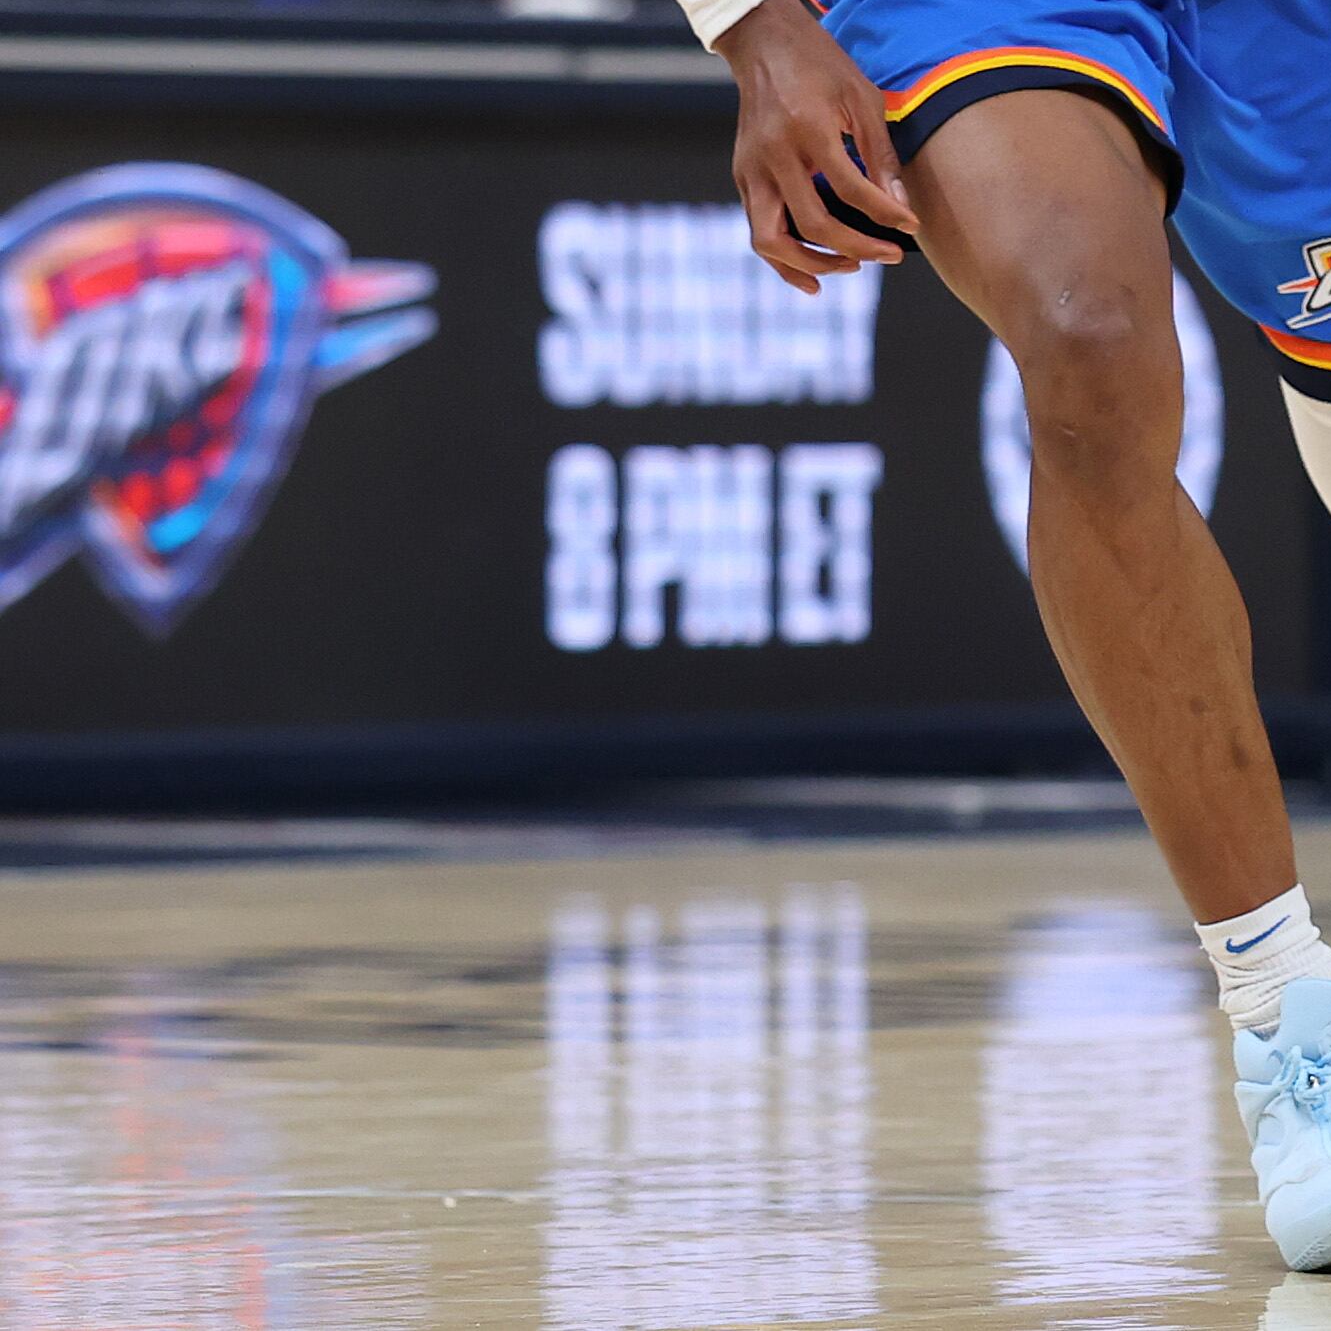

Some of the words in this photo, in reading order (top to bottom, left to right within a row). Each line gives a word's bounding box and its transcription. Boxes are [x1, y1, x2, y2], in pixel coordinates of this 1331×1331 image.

[540, 201, 880, 404] SUNDAY
[547, 444, 617, 649] 8
[623, 444, 773, 647] PM
[780, 444, 881, 643] ET
